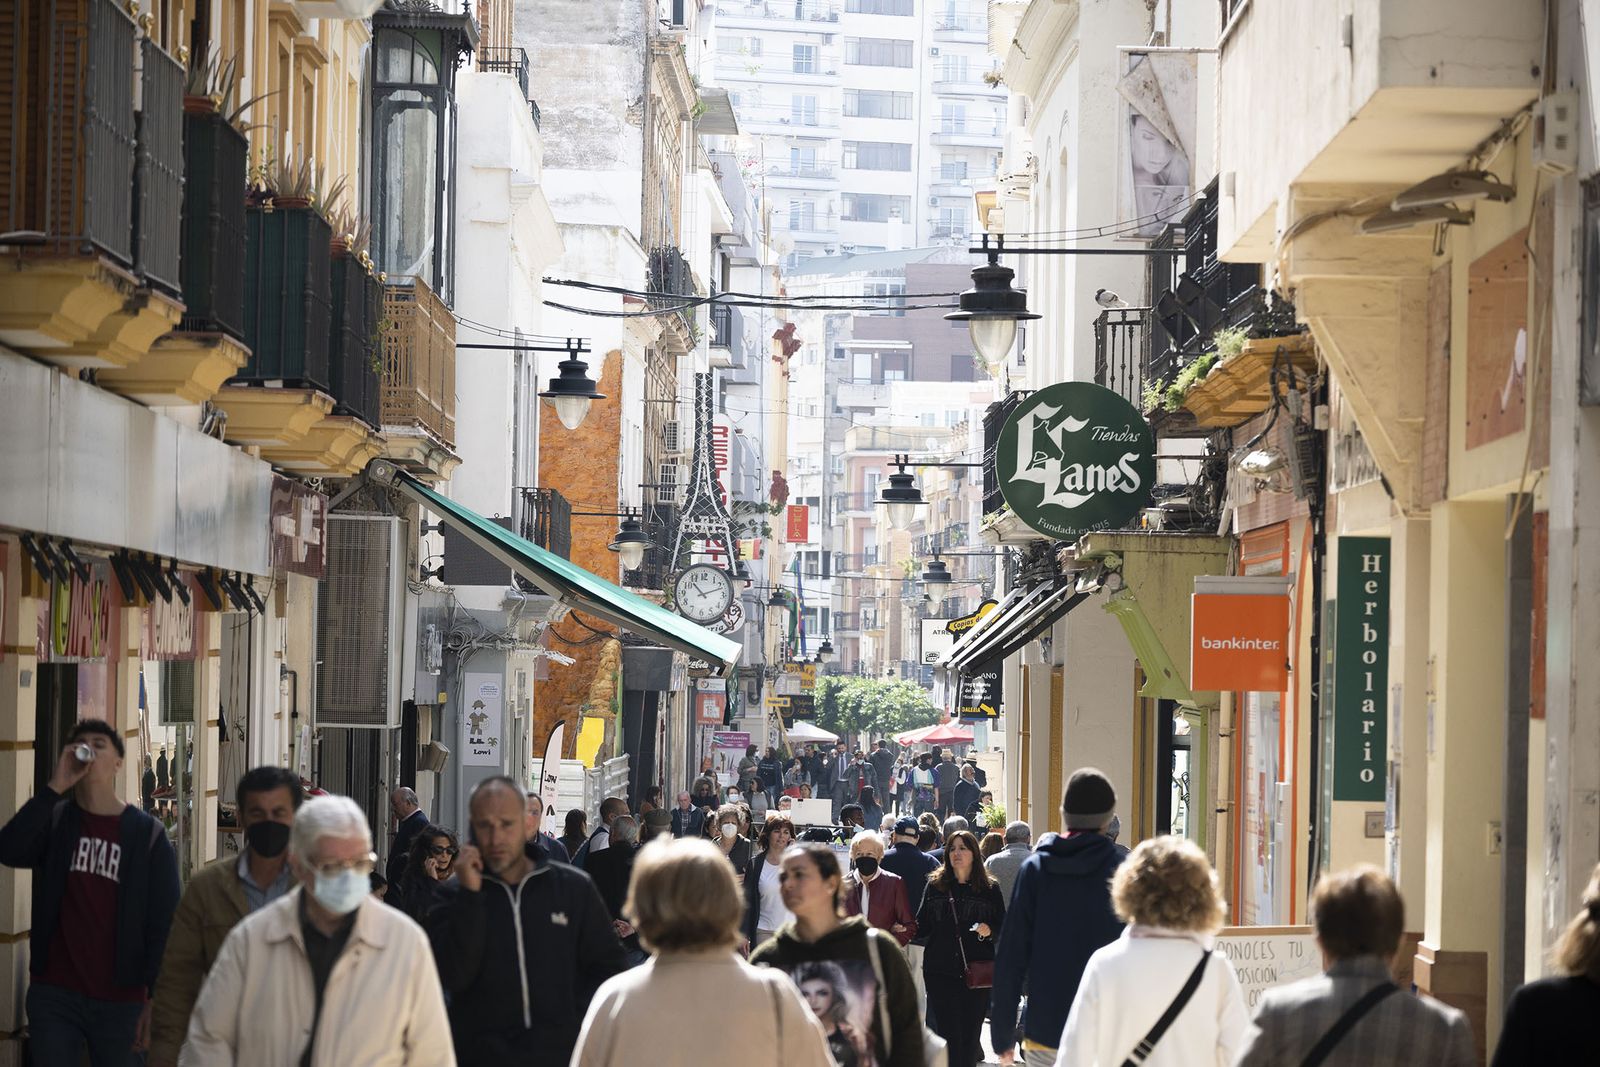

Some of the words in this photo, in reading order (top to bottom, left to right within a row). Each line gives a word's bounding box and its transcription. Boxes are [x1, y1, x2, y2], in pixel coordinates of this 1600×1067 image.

[1091, 424, 1141, 442] Tiendas
[1037, 517, 1076, 535] Fundada
[1091, 520, 1110, 532] 1915
[691, 575, 698, 583] 11
[700, 573, 708, 581] 12
[720, 591, 725, 599] 3
[953, 619, 974, 630] Copias
[1359, 554, 1382, 783] Herbolario
[70, 837, 121, 883] RVAR
[1288, 941, 1304, 958] TU
